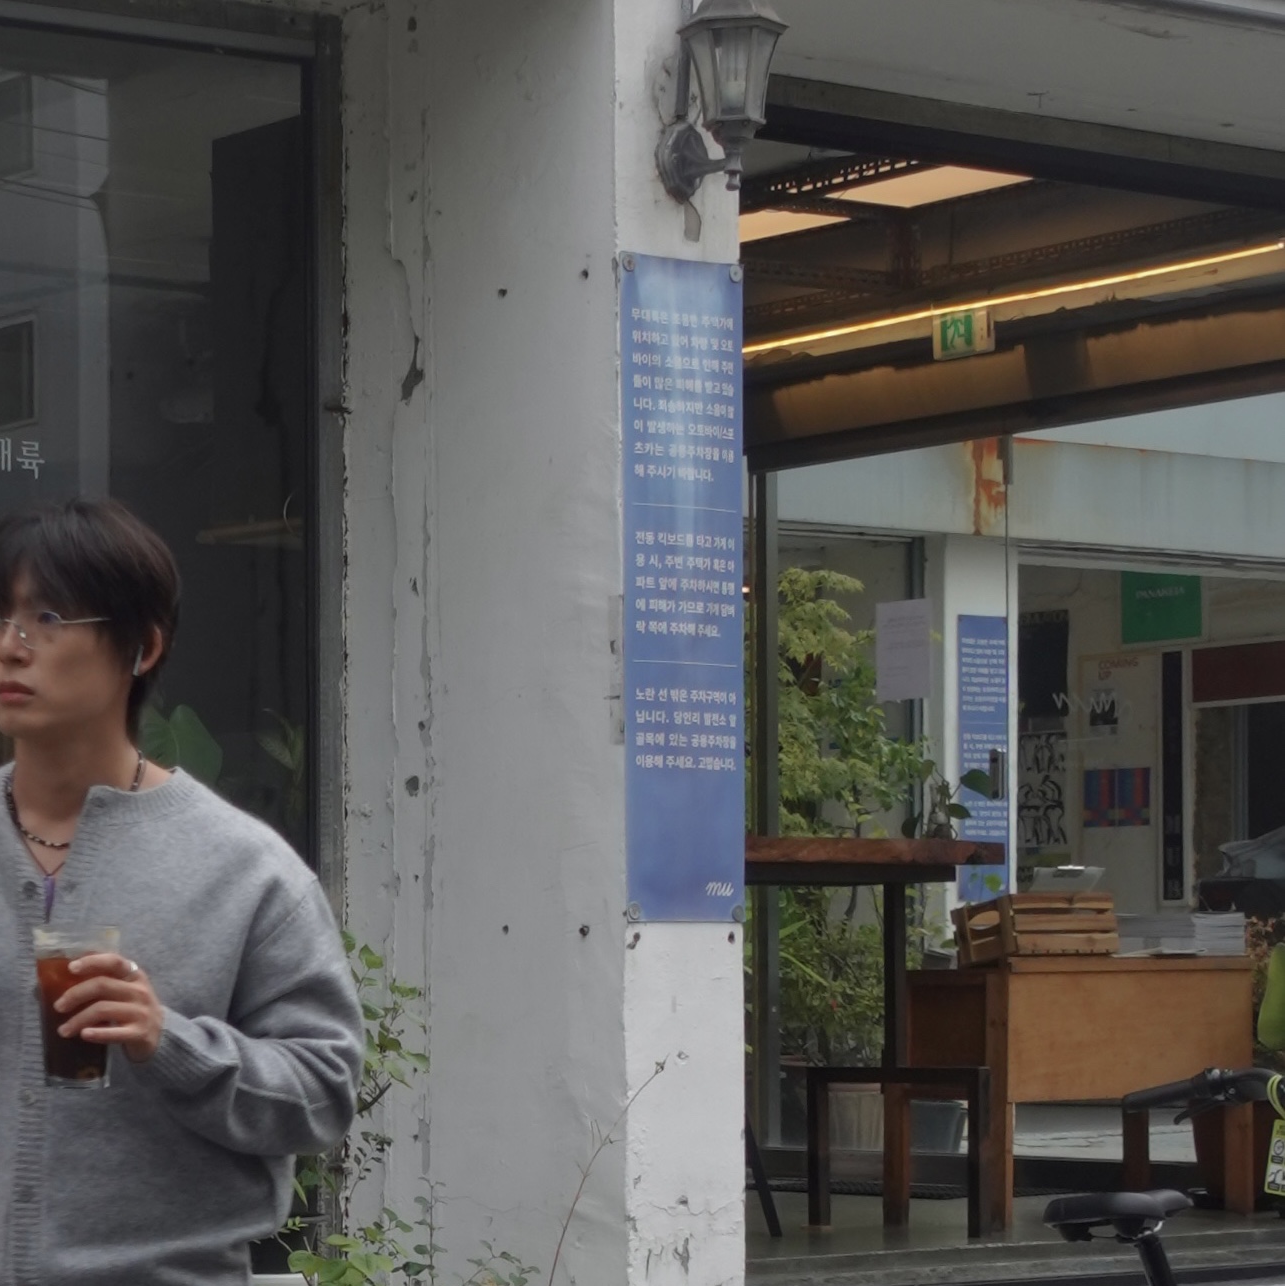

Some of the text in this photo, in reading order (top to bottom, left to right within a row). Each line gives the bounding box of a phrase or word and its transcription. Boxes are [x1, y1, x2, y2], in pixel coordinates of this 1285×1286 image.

[632, 330, 669, 346] 위치하고
[721, 340, 733, 352] 오토
[633, 353, 661, 366] 바이의
[702, 360, 719, 373] 인해
[633, 374, 651, 389] 들이
[654, 377, 672, 390] 많은
[705, 382, 720, 393] 받고
[634, 397, 655, 411] 니다.
[658, 400, 703, 415] 죄송하지만
[706, 404, 726, 417] 소음이
[634, 420, 643, 432] 이
[647, 421, 684, 435] 발생하는
[634, 442, 734, 463] 츠카는 공용주차장을 이용
[634, 464, 644, 477] 해
[647, 465, 675, 478] 주시기
[635, 531, 735, 551] 전동 킥보드를 타고 가게 이
[636, 554, 645, 567] 용
[649, 555, 662, 568] 시,
[665, 556, 683, 569] 주변
[686, 557, 710, 571] 주택가
[728, 561, 734, 573] 아
[635, 577, 655, 589] 파트
[659, 577, 677, 591] 앞에
[680, 579, 719, 594] 주차하시면
[636, 598, 646, 611] 에
[649, 599, 675, 612] 피해가
[678, 601, 704, 613] 가므로
[636, 621, 646, 633] 락
[649, 622, 667, 634] 쪽에
[670, 623, 696, 636] 주차해
[636, 688, 655, 701] 노란
[658, 689, 667, 701] 선
[690, 690, 727, 704] 주차구역이
[729, 693, 736, 705] 아
[636, 711, 669, 723] 닙니다.
[704, 713, 726, 726] 발전소
[636, 733, 736, 749] 골목에 있는 공용주차장을
[636, 755, 736, 771] 이용해 주세요. 고맙습니다.
[706, 881, 734, 896] mu
